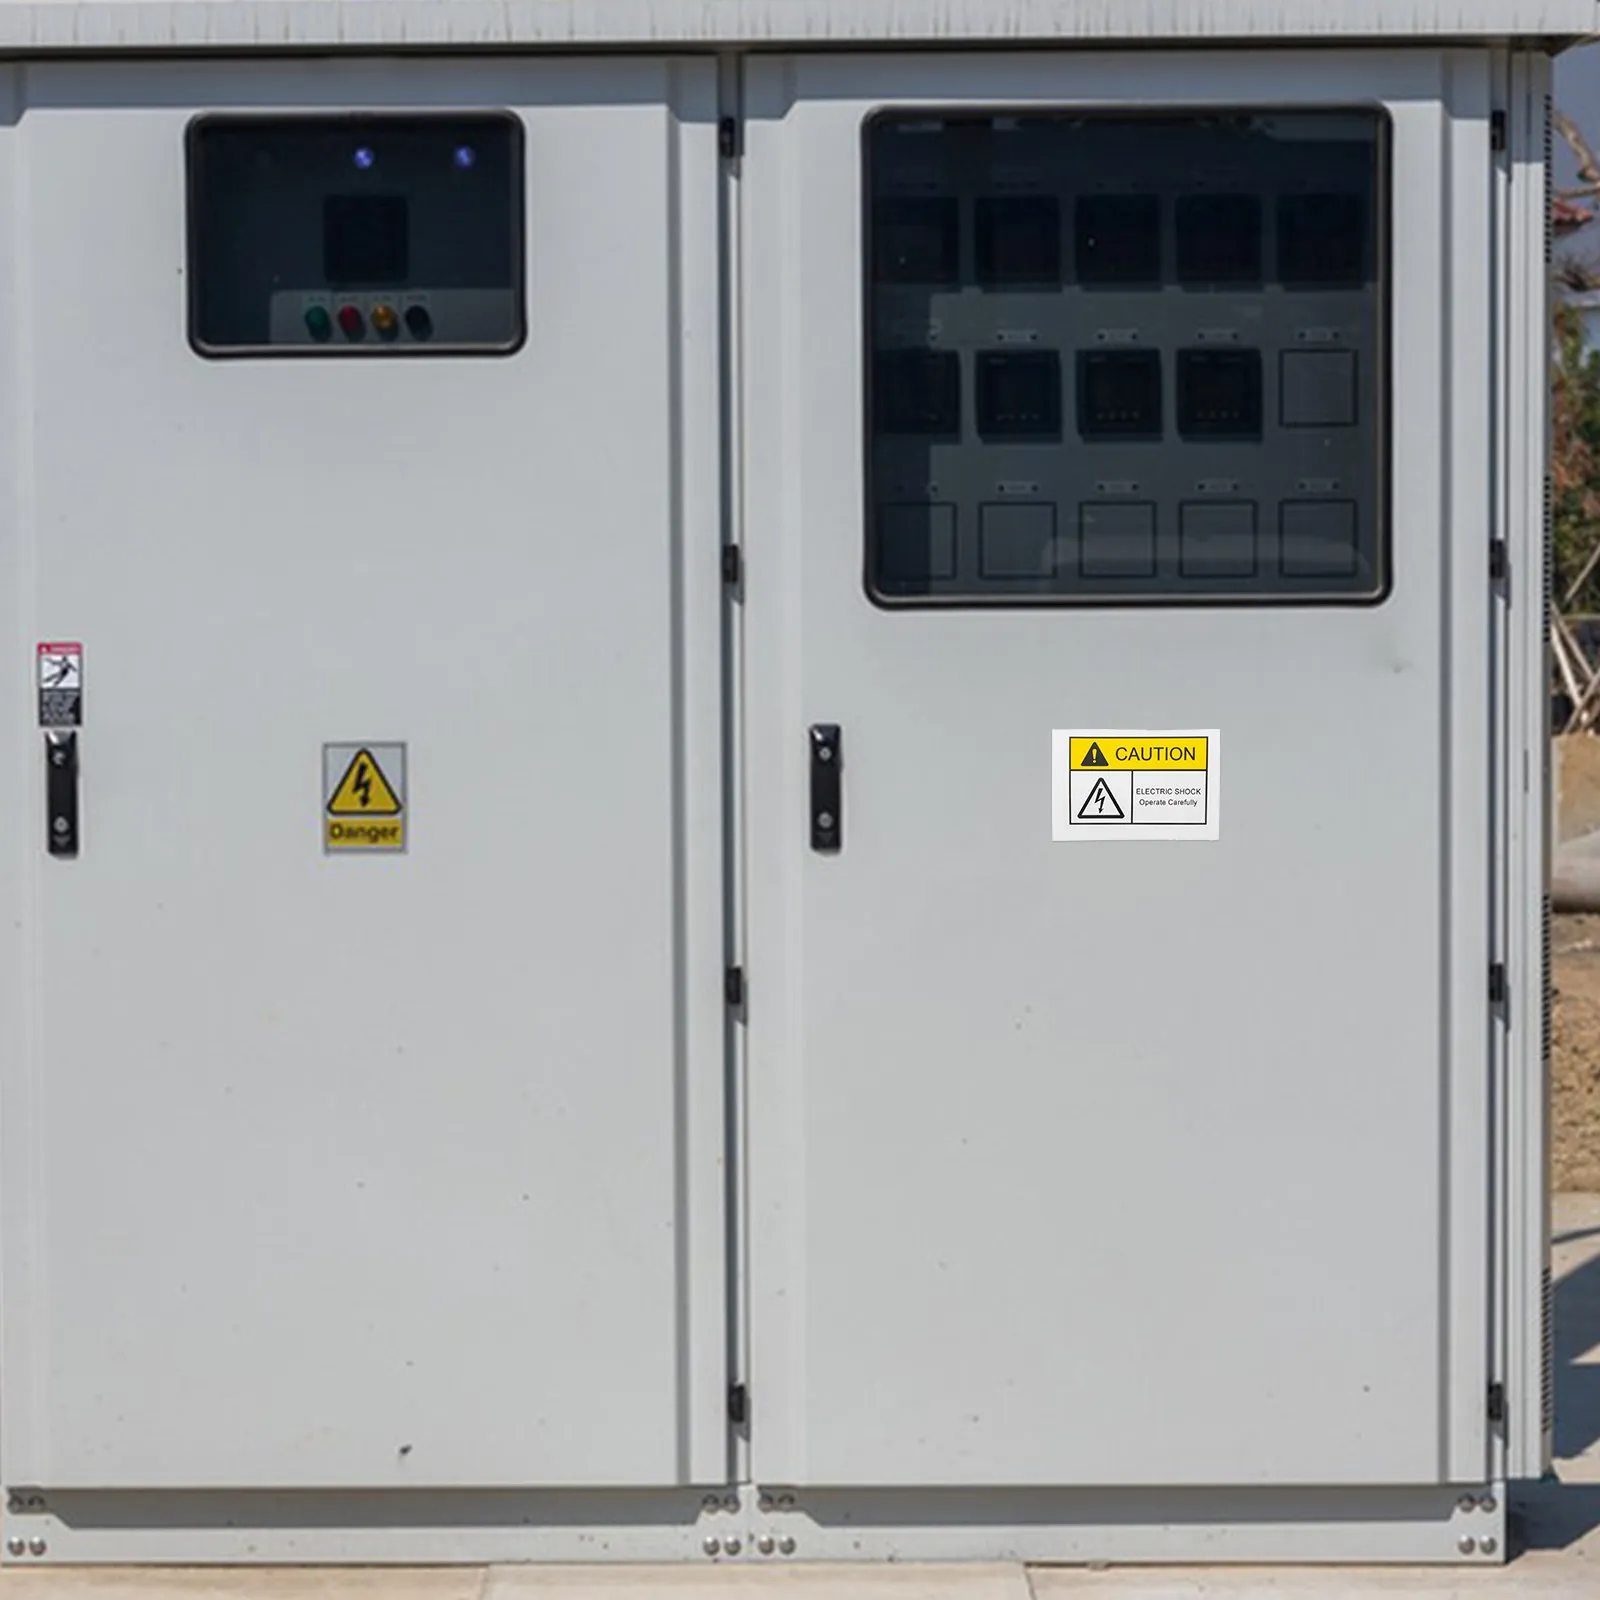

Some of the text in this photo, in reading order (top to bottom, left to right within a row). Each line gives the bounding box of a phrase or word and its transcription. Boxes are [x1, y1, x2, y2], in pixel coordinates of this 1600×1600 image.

[1115, 746, 1196, 762] CAUTION
[1136, 787, 1201, 795] ELECTRIC SHOCK
[1139, 798, 1198, 807] Operate Carefully
[329, 823, 399, 843] Danger
